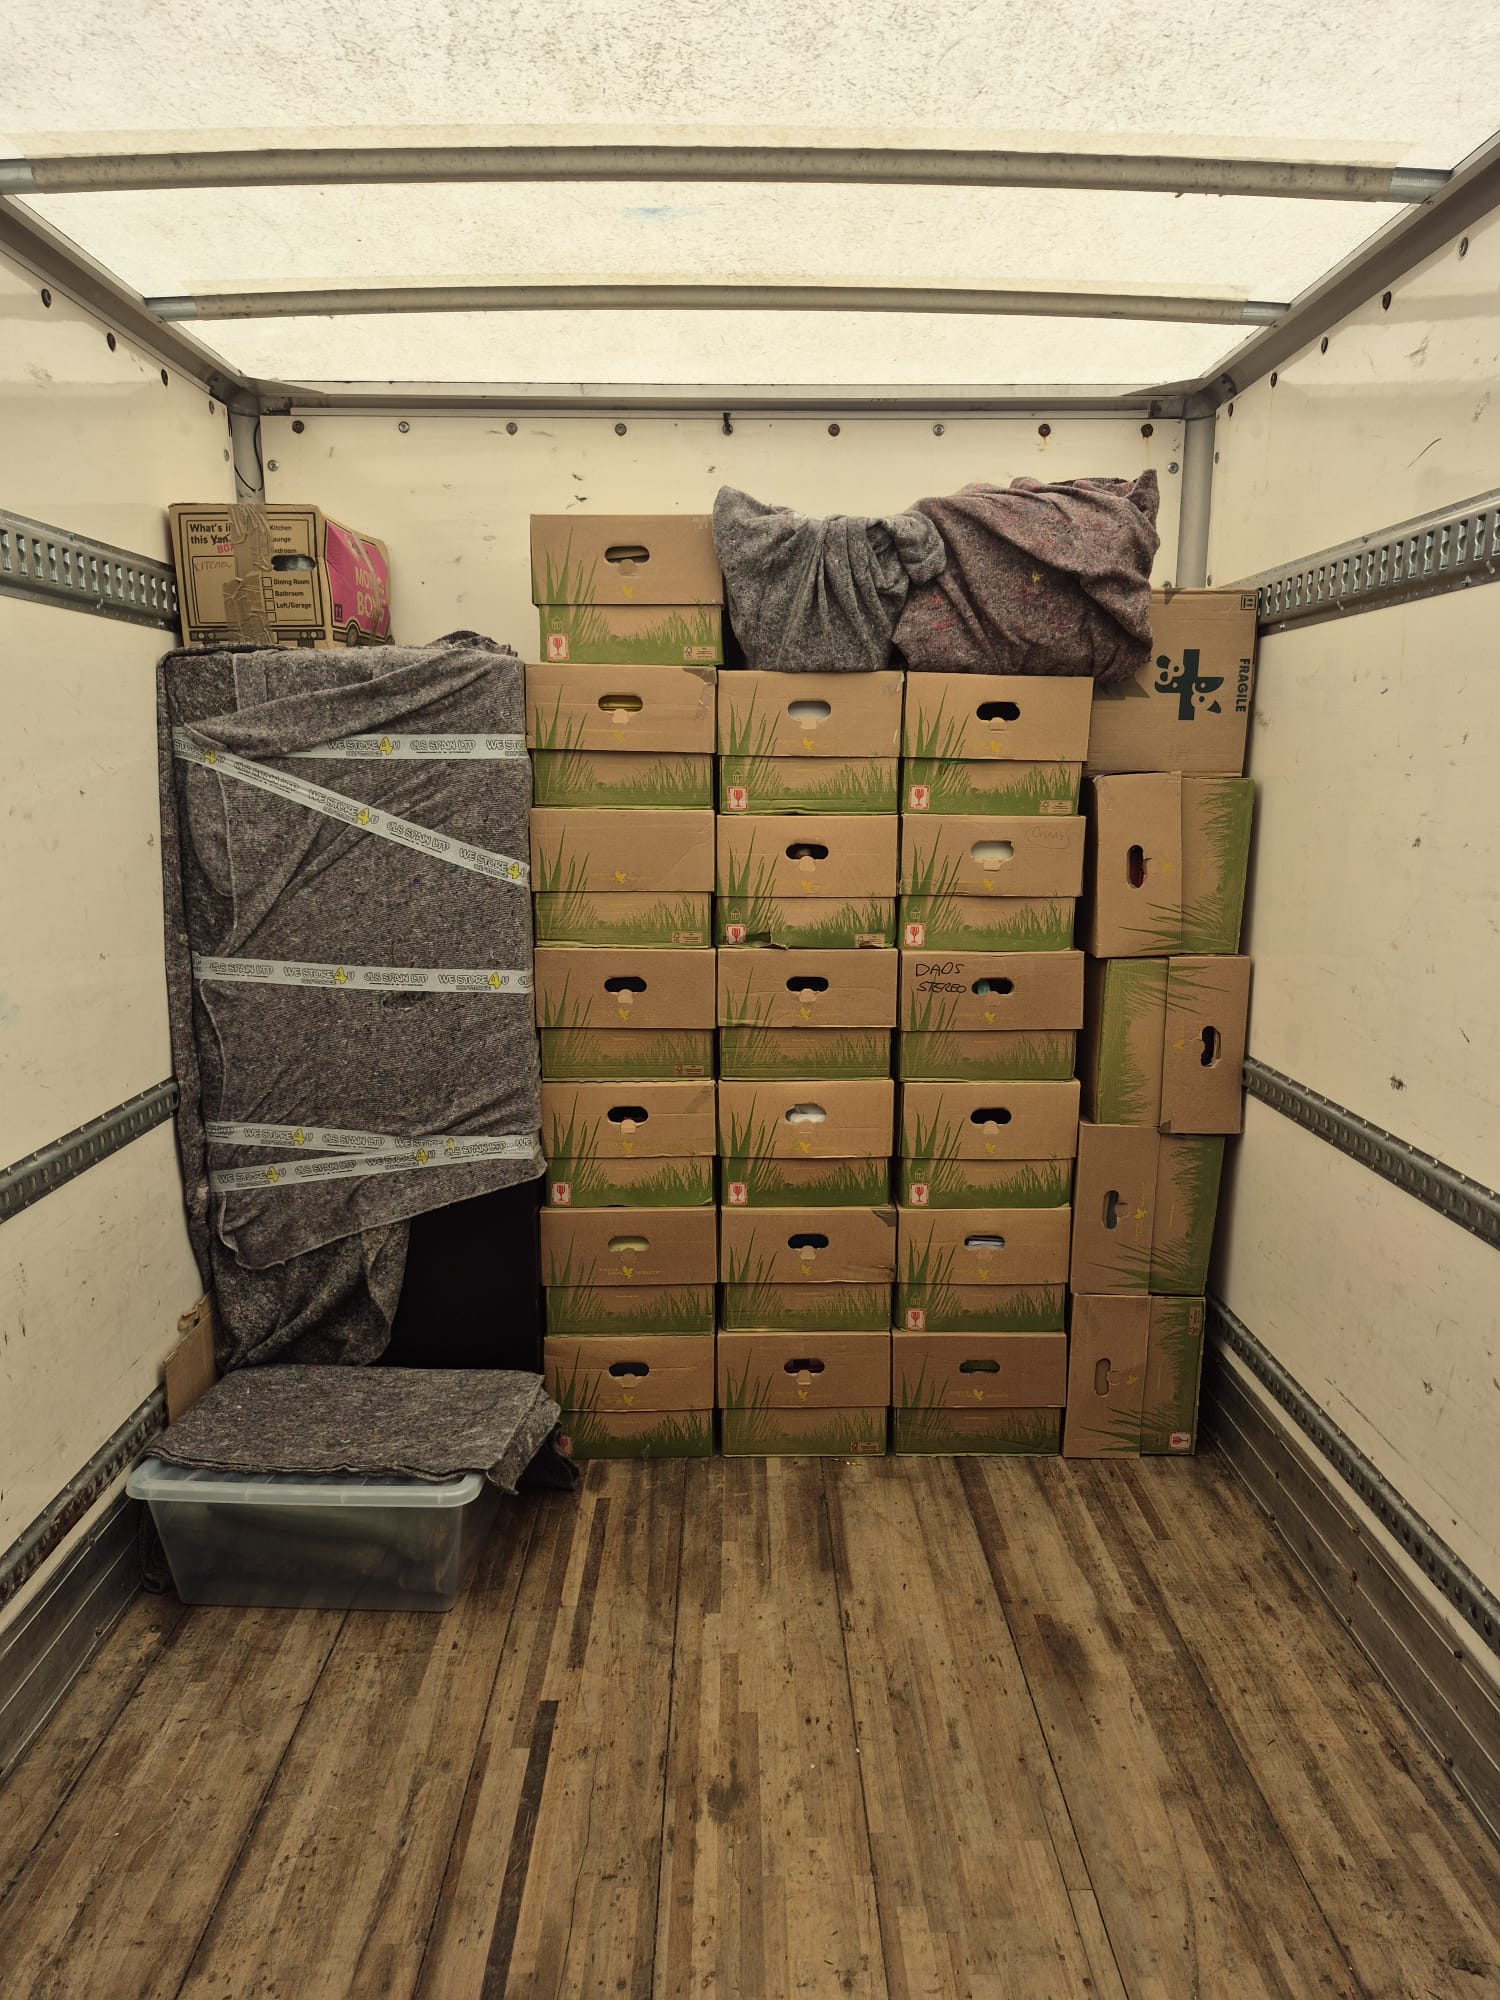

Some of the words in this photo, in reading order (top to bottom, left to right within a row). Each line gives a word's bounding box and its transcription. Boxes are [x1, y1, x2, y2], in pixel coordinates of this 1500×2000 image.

[190, 523, 222, 532] What's
[191, 535, 208, 544] this
[276, 601, 312, 609] Loft/Garage
[1235, 658, 1251, 713] FRAGILE
[327, 740, 345, 750] WE
[346, 740, 379, 750] STORE
[429, 740, 457, 751] SPAIN
[458, 740, 476, 751] LTD
[486, 740, 504, 751] WE
[308, 789, 326, 803] WE
[326, 796, 359, 816] STORE
[356, 807, 370, 825] 4
[404, 827, 432, 845] SPAIN
[431, 840, 450, 851] LTD
[459, 848, 476, 861] WE
[476, 854, 508, 870] STORE
[506, 862, 521, 879] 4
[228, 963, 255, 975] SPAIN
[255, 964, 273, 975] LTD
[283, 966, 301, 977] WE
[301, 968, 333, 979] STORE
[333, 967, 347, 984] 4
[382, 972, 409, 983] SPAIN
[409, 974, 428, 984] LTD
[438, 975, 456, 985] WE
[456, 975, 488, 985] STORE
[487, 971, 501, 989] 4
[916, 981, 967, 993] STEREO
[243, 1128, 260, 1138] WE
[261, 1129, 293, 1140] STORE
[292, 1128, 305, 1146] 4
[339, 1135, 367, 1146] SPAIN
[367, 1136, 385, 1147] LTD
[395, 1137, 412, 1148] WE
[217, 1173, 235, 1184] WE
[266, 1165, 279, 1183] 4
[312, 1162, 339, 1173] SPAIN
[339, 1160, 357, 1170] LTD
[365, 1157, 384, 1167] WE
[462, 1143, 488, 1154] SPAIN
